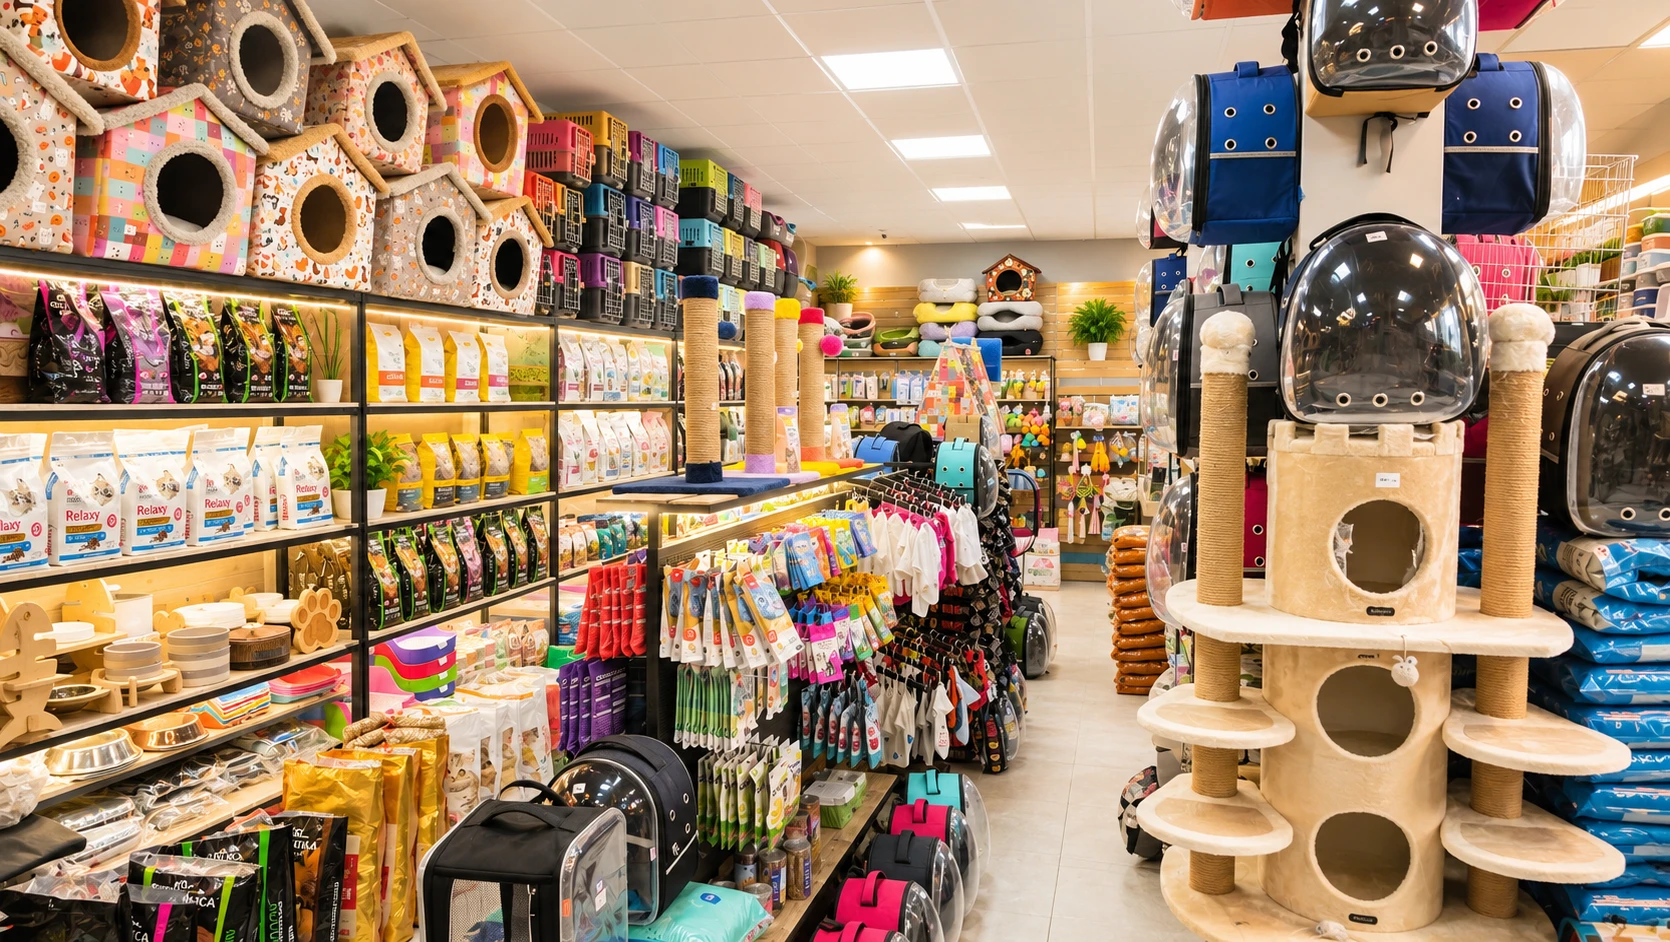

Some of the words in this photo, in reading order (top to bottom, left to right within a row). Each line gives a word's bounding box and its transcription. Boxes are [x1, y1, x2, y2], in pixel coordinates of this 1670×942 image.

[205, 498, 231, 508] Relaxy
[66, 509, 101, 522] Relaxy
[137, 505, 168, 516] Relaxy
